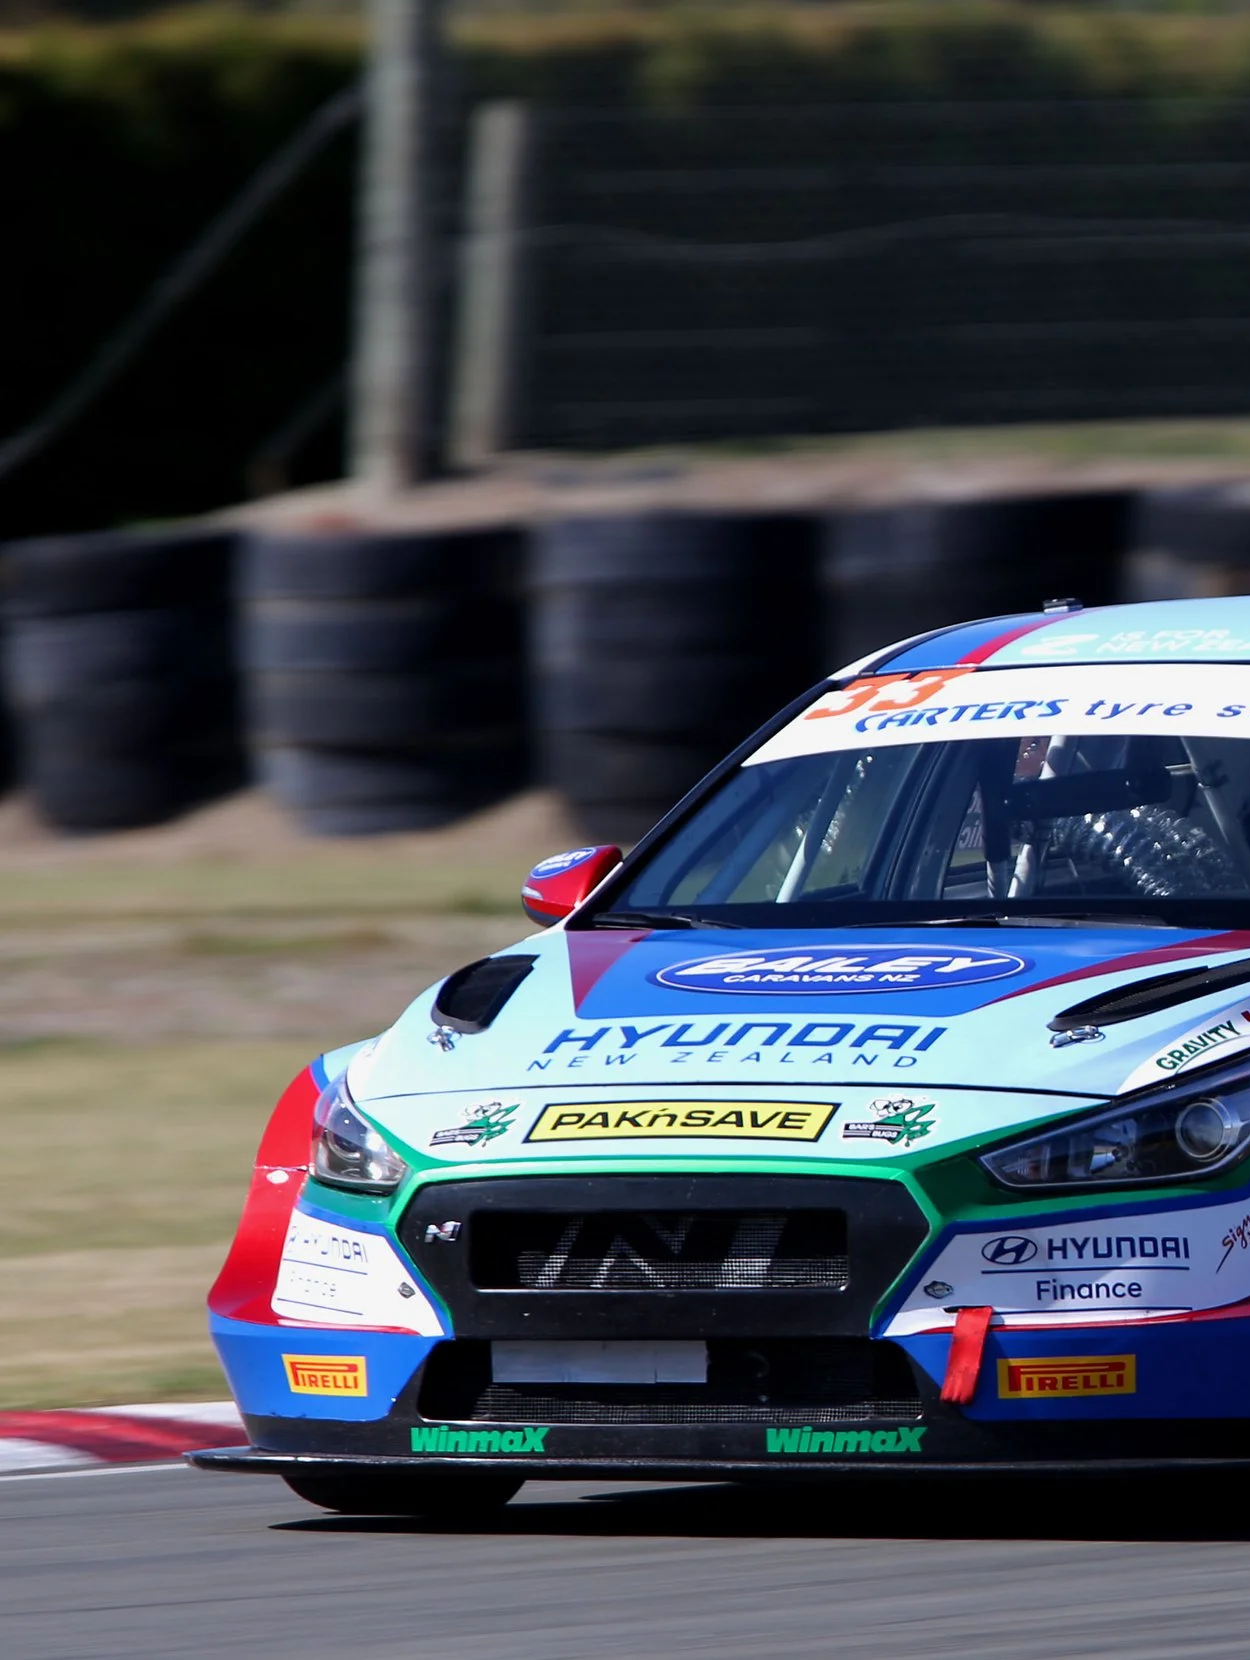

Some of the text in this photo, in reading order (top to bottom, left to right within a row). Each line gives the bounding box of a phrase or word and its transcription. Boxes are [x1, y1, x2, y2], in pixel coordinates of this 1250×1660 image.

[1095, 640, 1182, 654] NEW
[803, 667, 977, 721] 33
[854, 698, 1069, 733] CARTER'S
[1085, 698, 1193, 721] tyre
[674, 956, 1010, 976] BAILEY
[722, 973, 921, 983] CARAVANS NZ
[542, 1022, 948, 1054] HYUNDAI
[1155, 1020, 1241, 1071] GRAVITY
[526, 1050, 919, 1072] NEW ZEALAND
[1047, 1236, 1190, 1260] HYUNDAI
[1036, 1278, 1142, 1301] Finance
[289, 1360, 359, 1390] PIRELLI
[1007, 1360, 1126, 1393] PIRELLI
